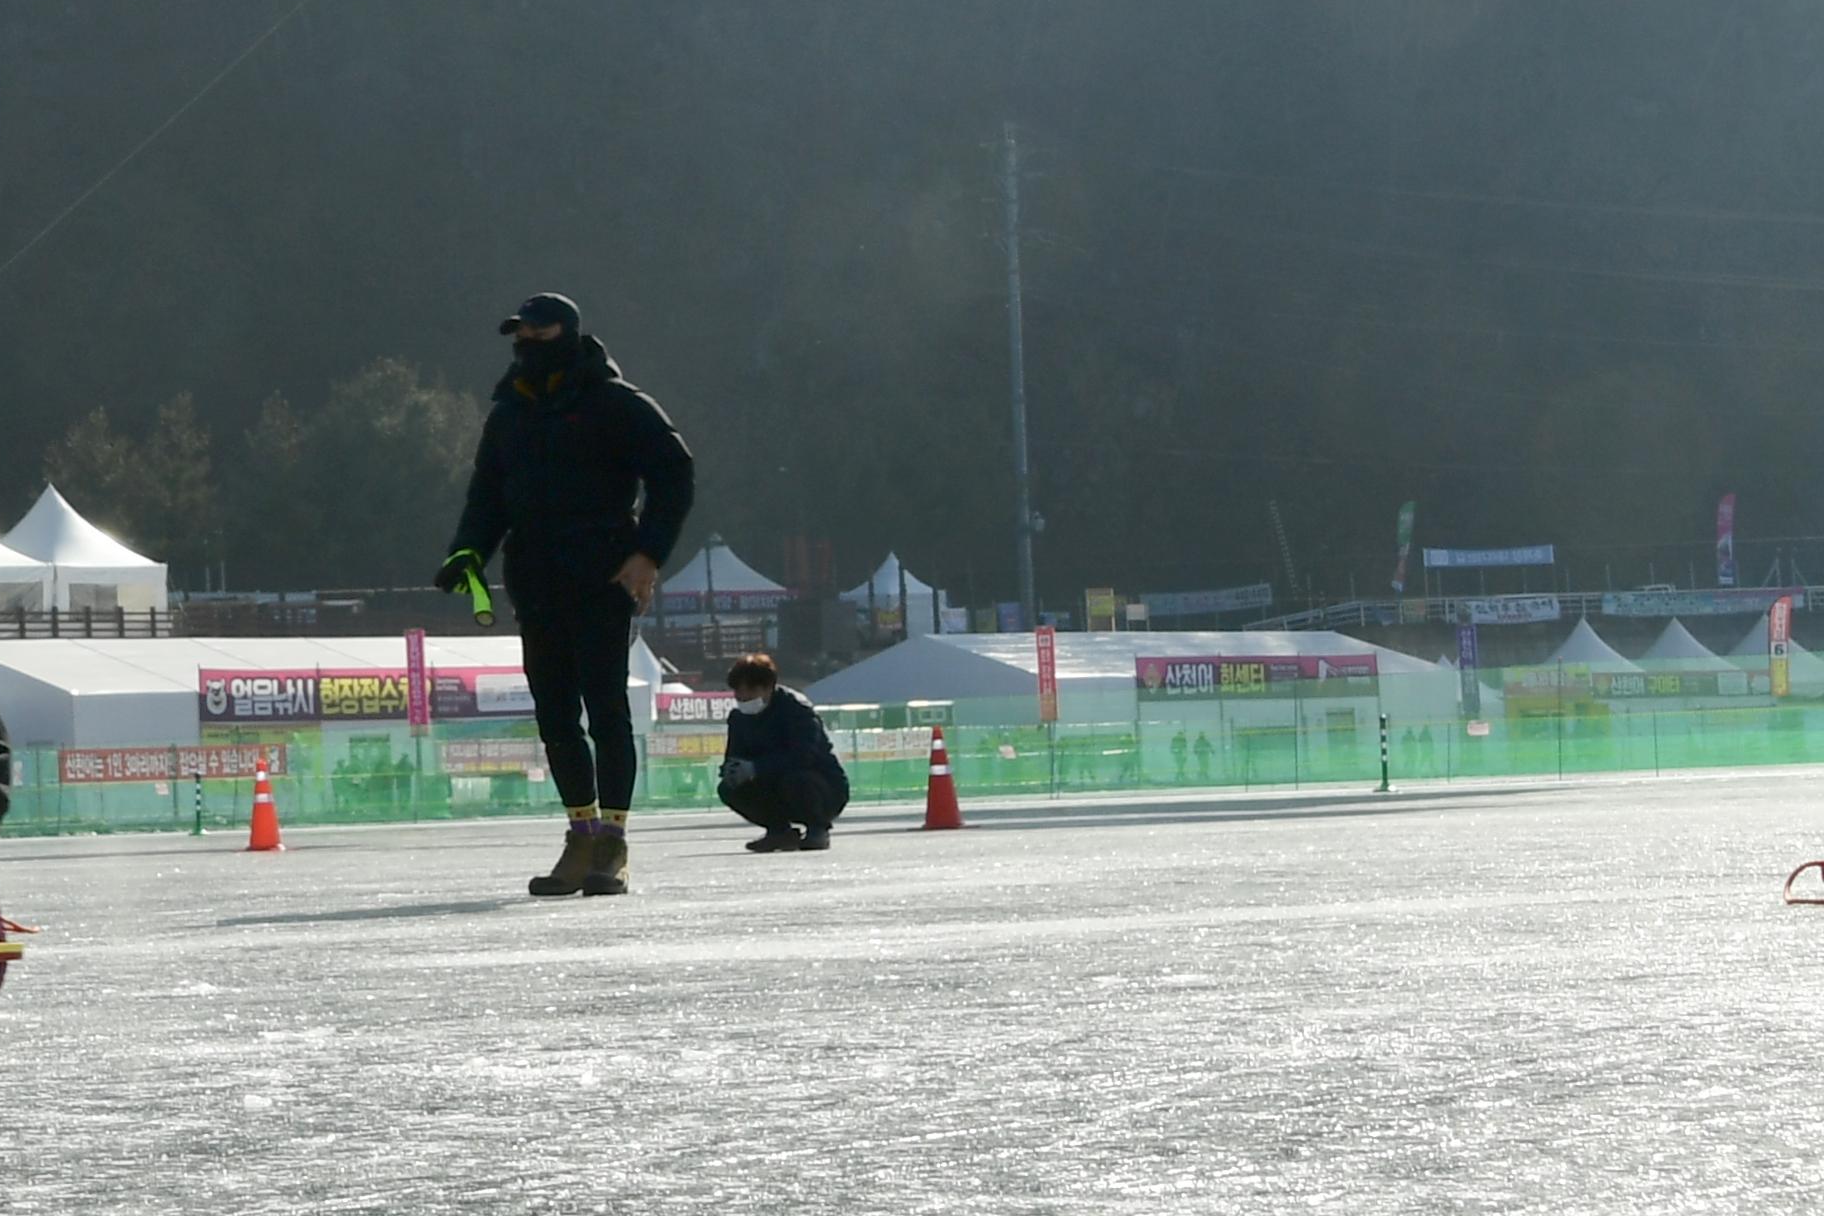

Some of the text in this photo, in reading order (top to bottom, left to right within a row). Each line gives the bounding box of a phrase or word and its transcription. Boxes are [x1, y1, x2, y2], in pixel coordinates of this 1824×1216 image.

[1774, 643, 1784, 656] 6
[1165, 663, 1214, 695] 산천어
[231, 677, 315, 716] 얼음낚시
[668, 697, 708, 720] 산천어
